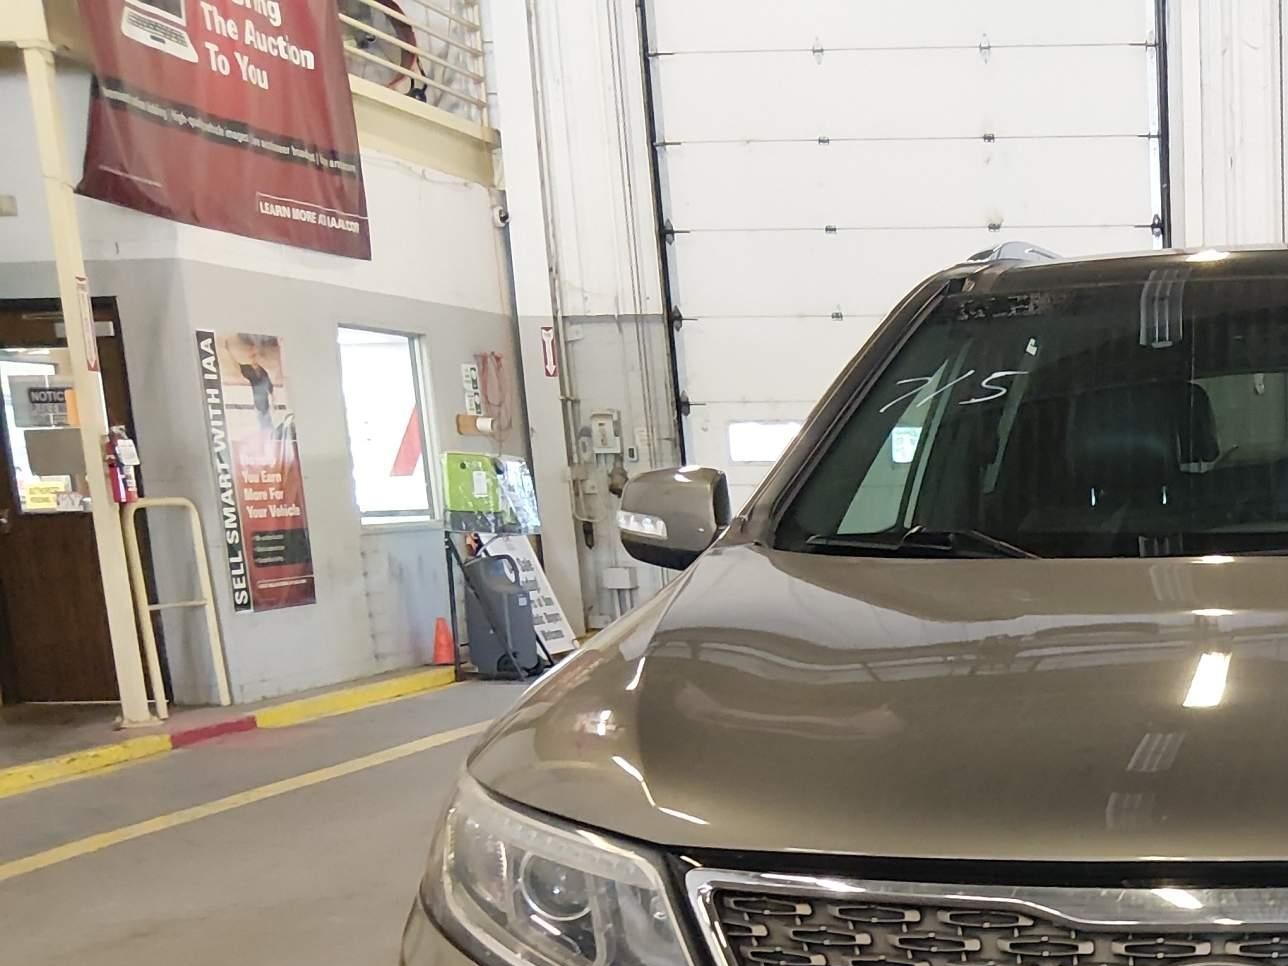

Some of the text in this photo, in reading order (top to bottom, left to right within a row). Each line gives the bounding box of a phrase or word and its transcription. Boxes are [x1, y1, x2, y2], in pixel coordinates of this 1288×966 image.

[202, 2, 315, 70] The Auction
[205, 42, 269, 90] To You
[259, 201, 290, 219] LEARN
[292, 208, 316, 224] MORE
[31, 391, 65, 402] NOTIC
[200, 338, 249, 604] SELL SMART WITH IAA
[241, 470, 260, 483] You
[243, 487, 284, 501] More For
[246, 503, 300, 519] Your Vehicle
